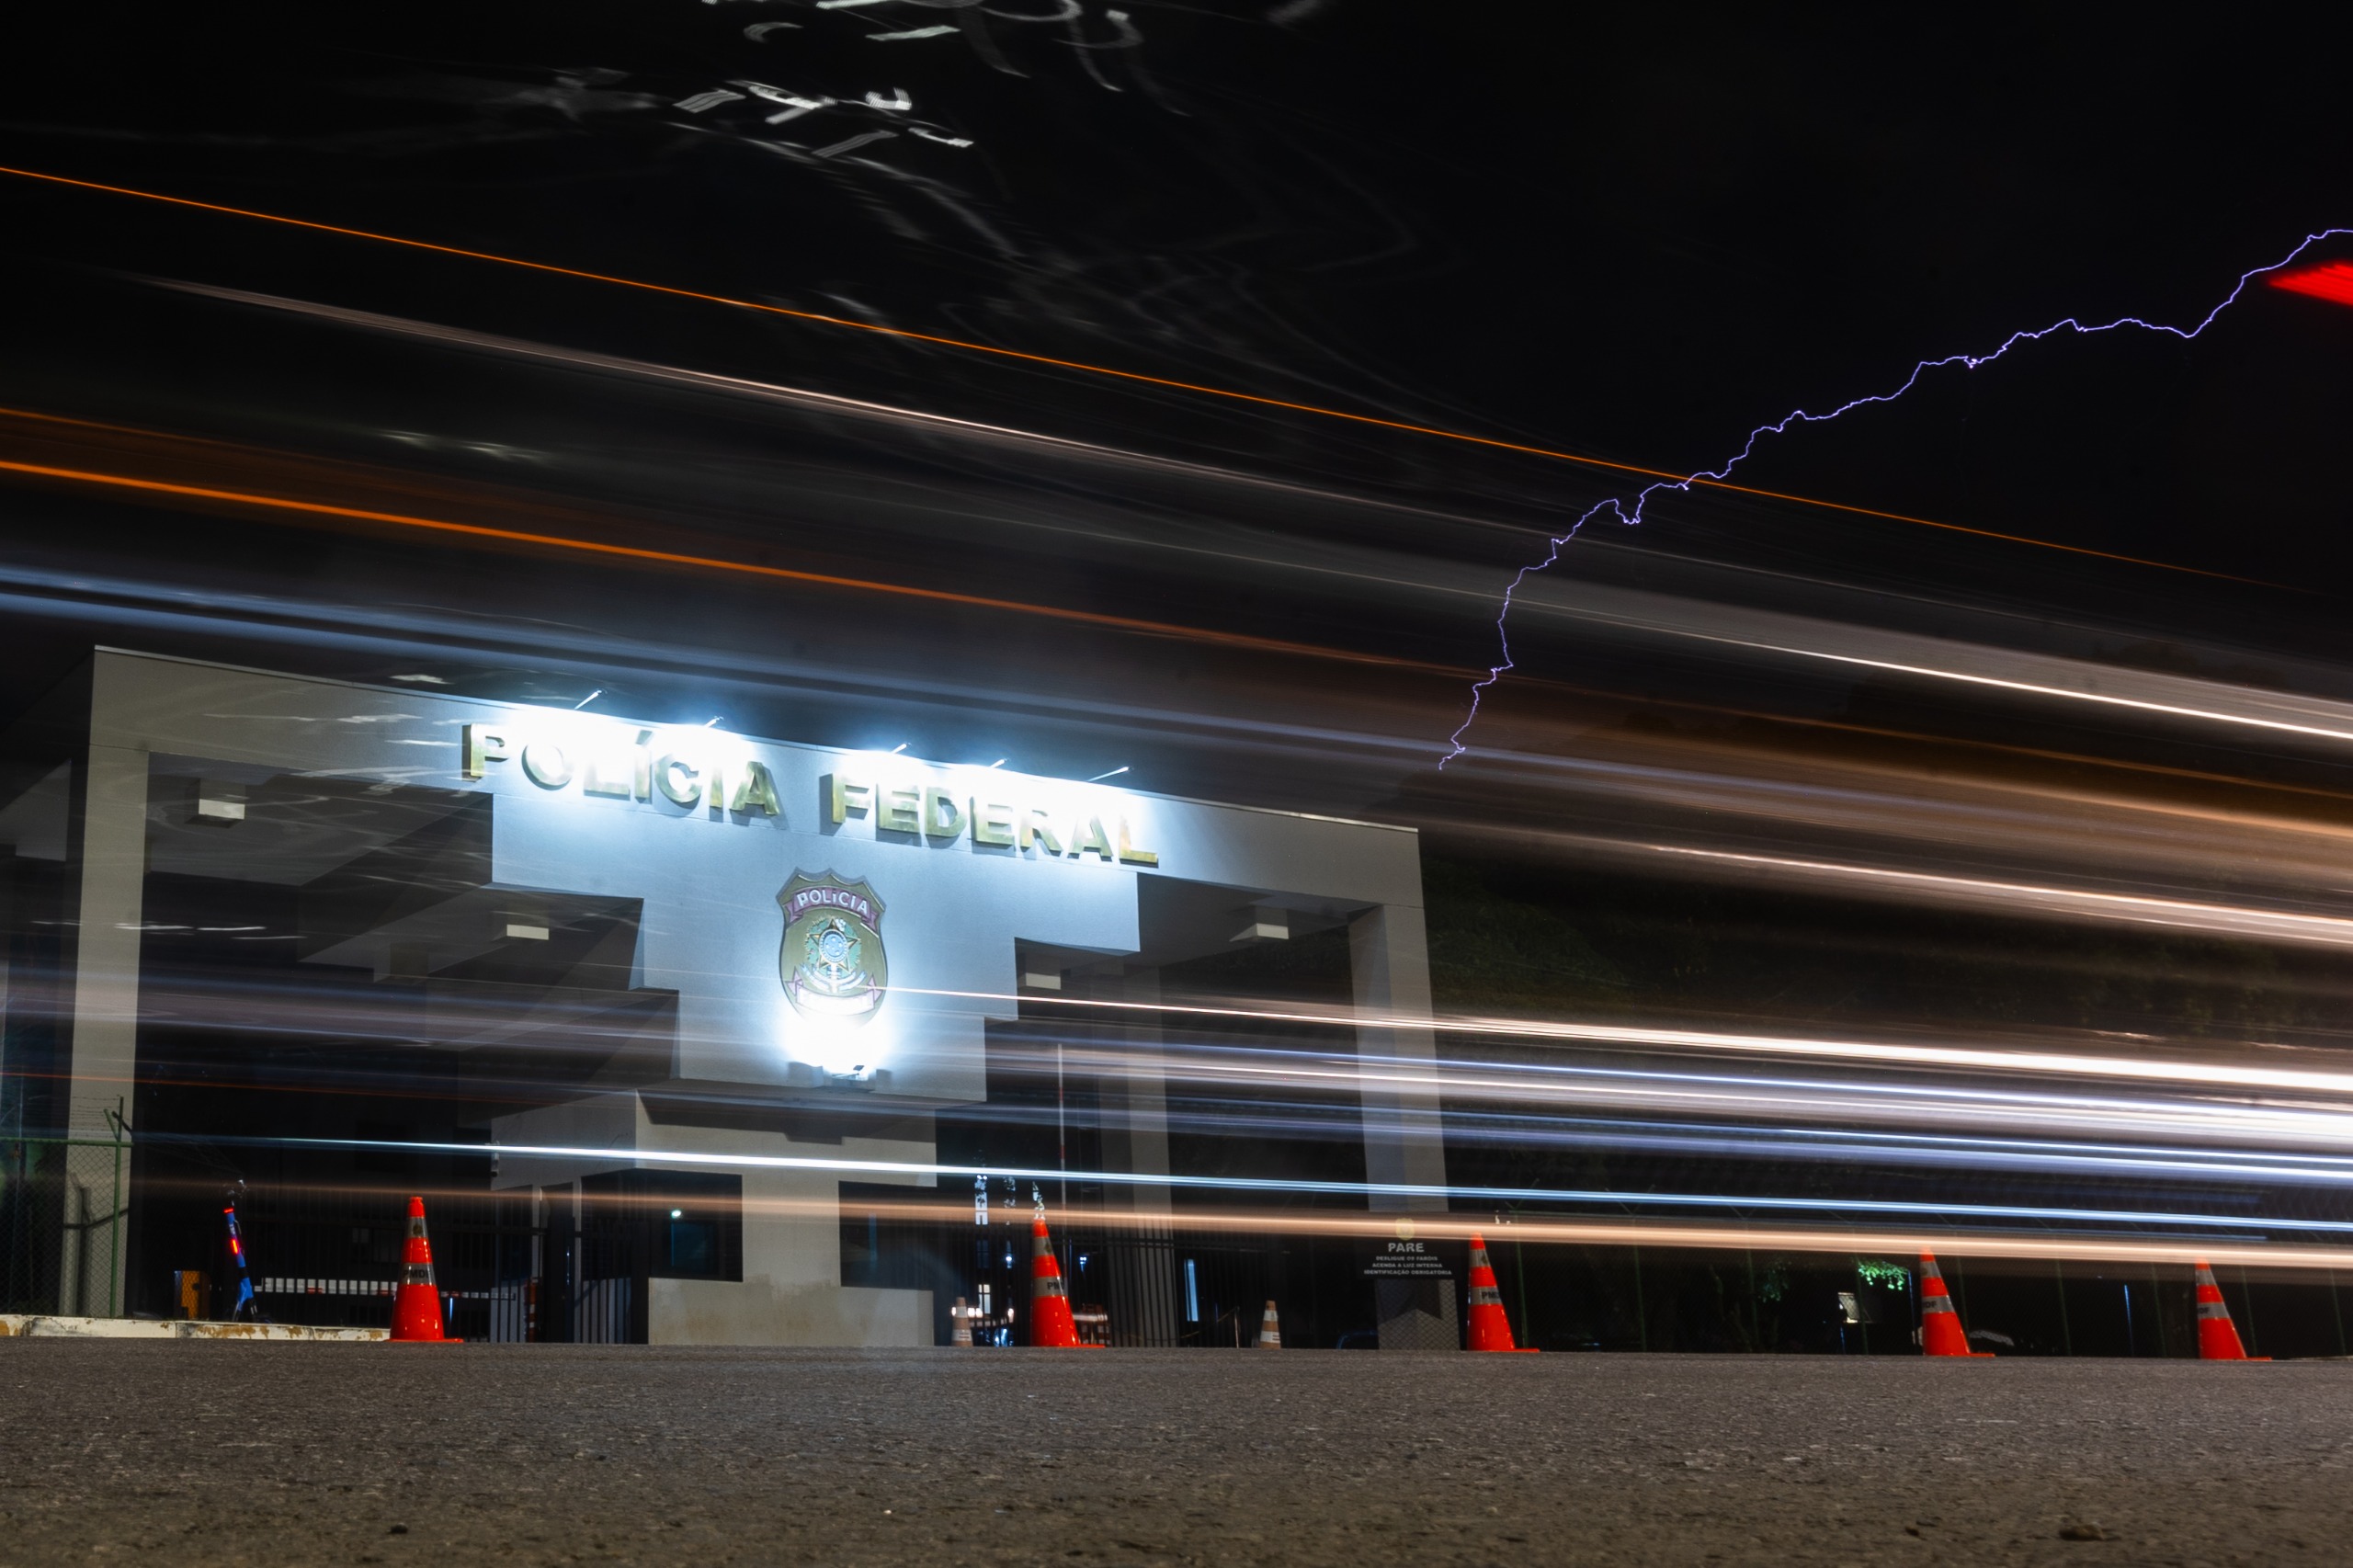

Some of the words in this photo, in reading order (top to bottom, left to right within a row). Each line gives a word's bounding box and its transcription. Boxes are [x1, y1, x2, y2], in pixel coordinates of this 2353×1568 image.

[462, 723, 780, 816] POLÍCIA
[830, 773, 1159, 869] FEDERAL
[1388, 1242, 1425, 1253] PARE
